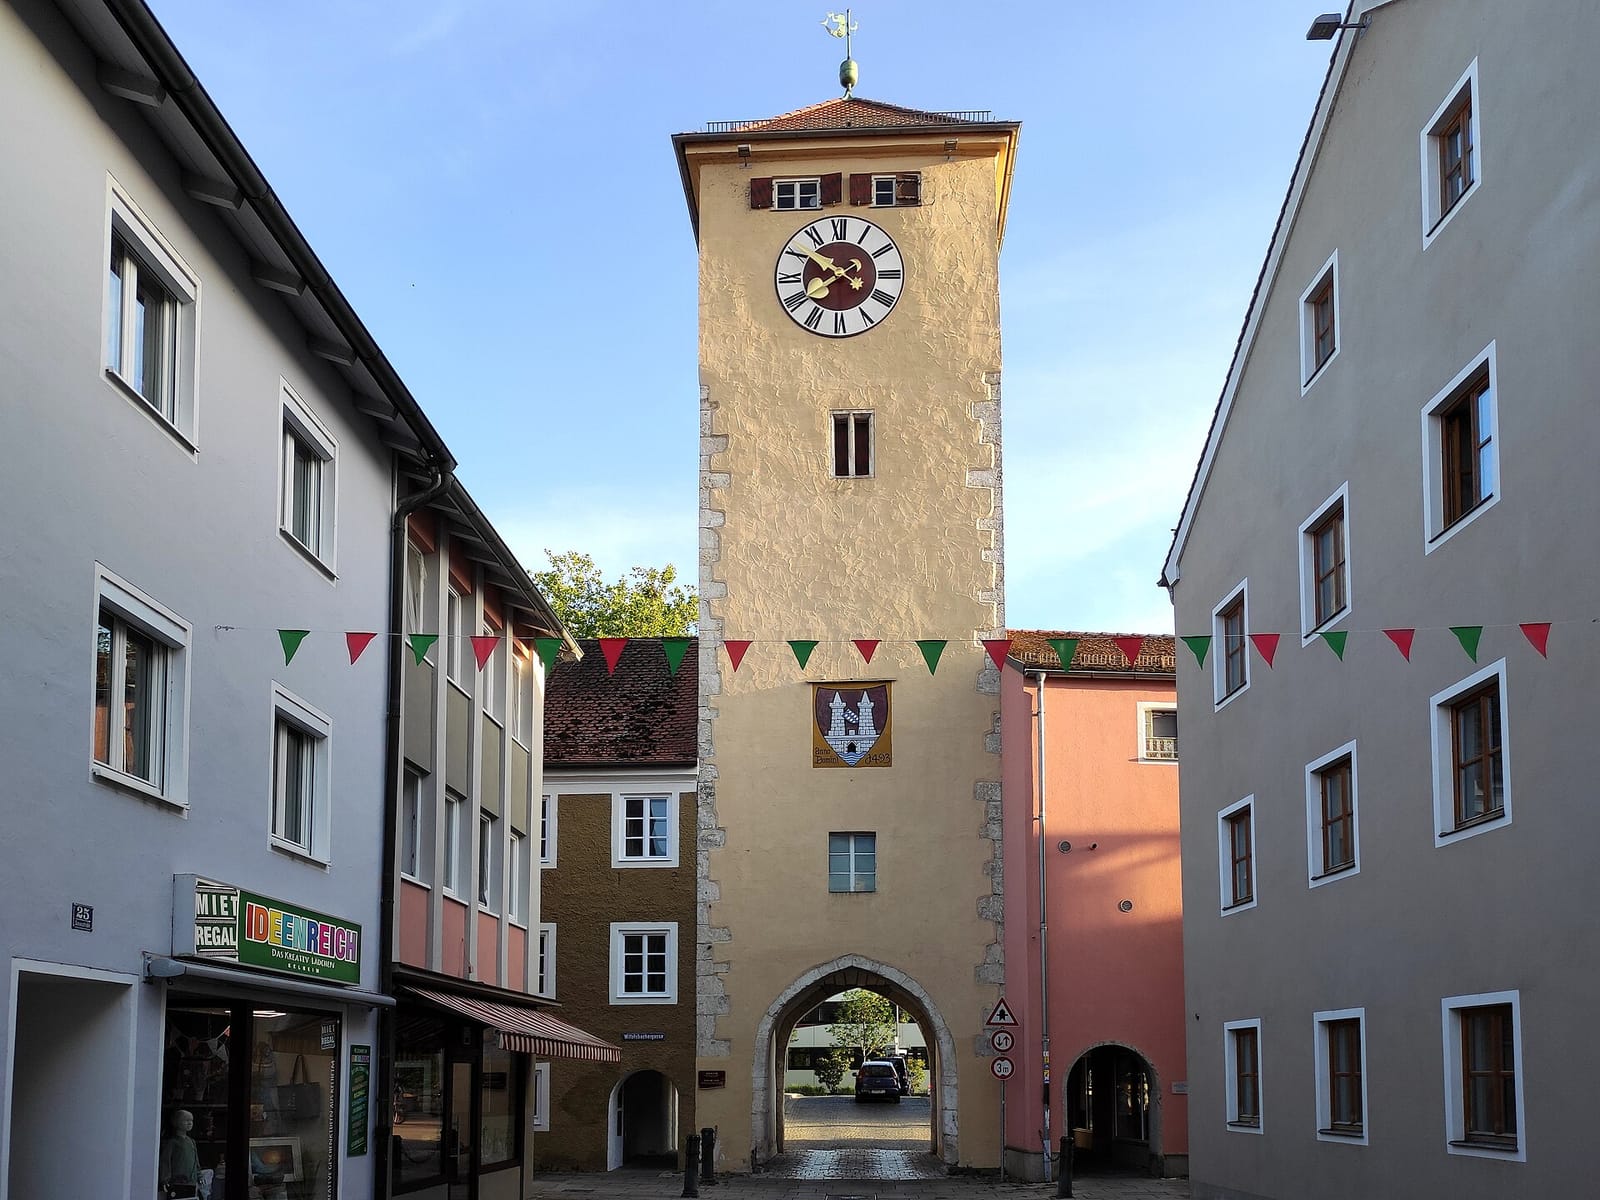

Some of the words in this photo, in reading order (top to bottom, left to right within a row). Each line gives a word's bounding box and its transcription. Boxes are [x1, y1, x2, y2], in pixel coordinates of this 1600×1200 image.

[803, 225, 825, 249] XI
[831, 218, 848, 241] XII
[857, 224, 872, 244] I
[785, 246, 809, 264] X
[872, 242, 894, 259] II
[778, 272, 802, 284] IX
[878, 269, 901, 280] III
[783, 290, 809, 313] VIII
[870, 288, 896, 308] IIII
[804, 305, 825, 330] VII
[834, 311, 847, 334] VI
[858, 306, 875, 327] V
[76, 906, 90, 920] 25
[196, 893, 238, 916] MIET
[196, 925, 237, 946] REGAL
[245, 901, 359, 964] IDEENREICH
[284, 951, 310, 964] KREATIV
[996, 1063, 1002, 1073] 3
